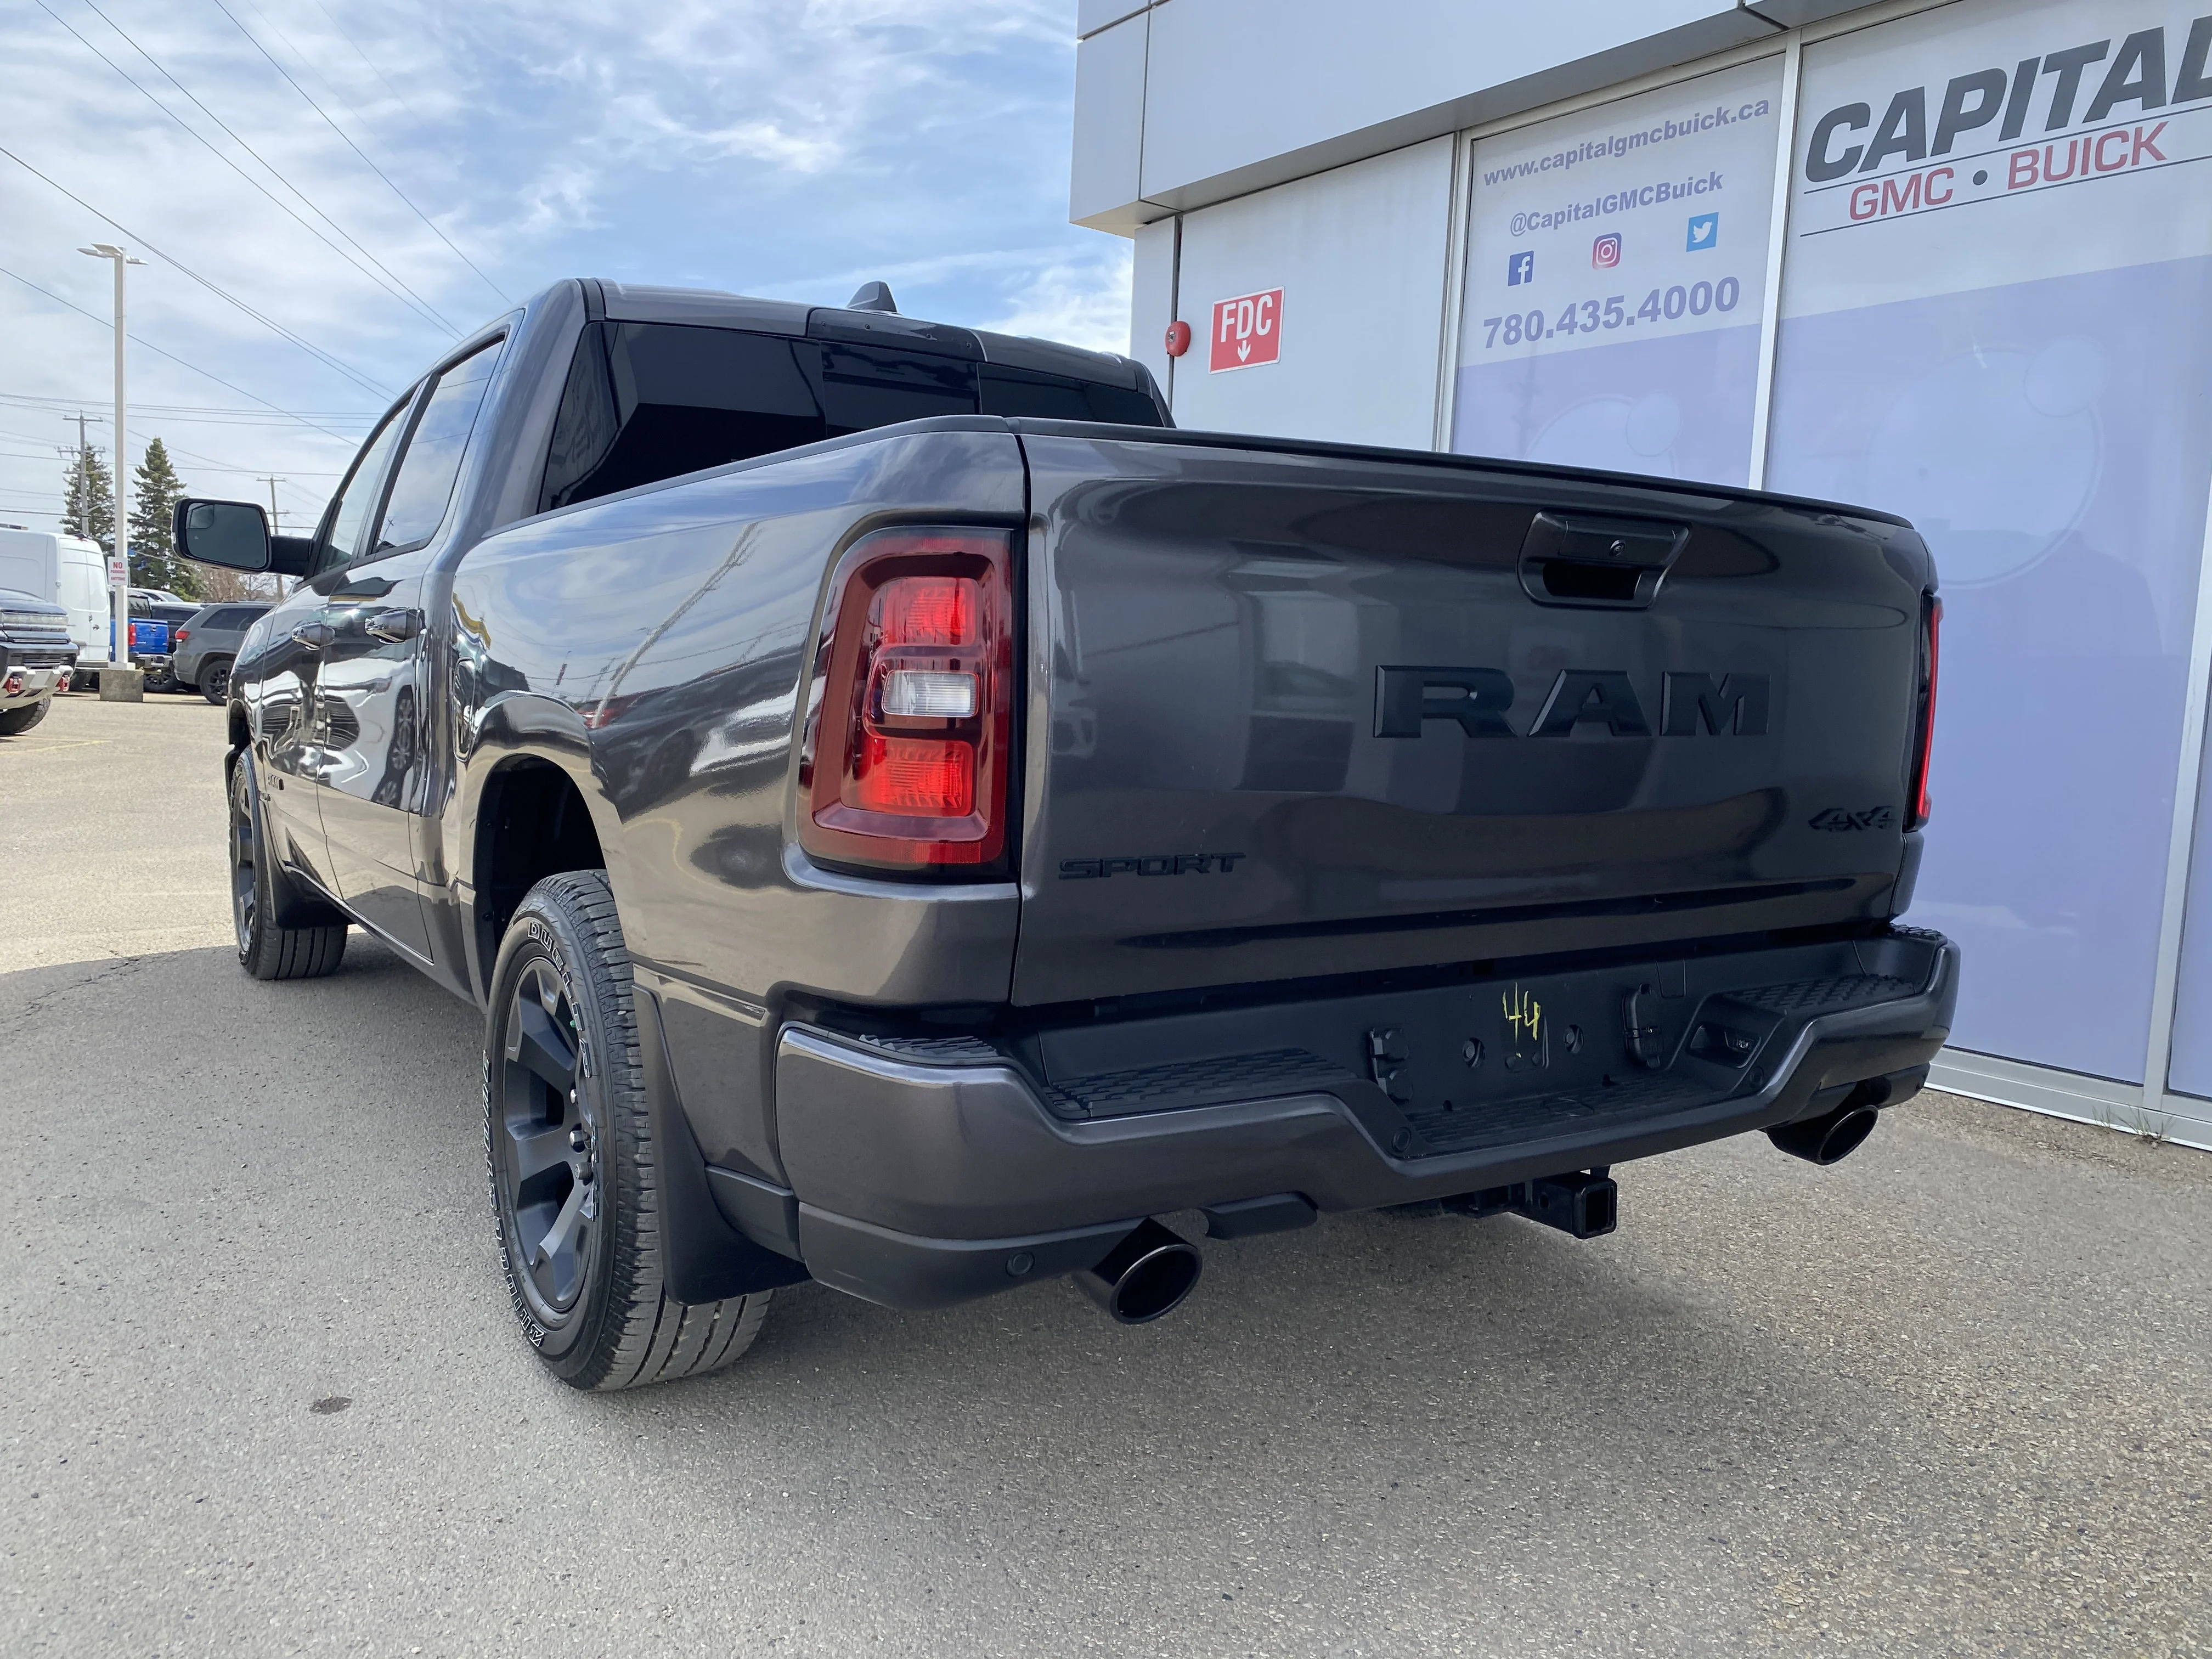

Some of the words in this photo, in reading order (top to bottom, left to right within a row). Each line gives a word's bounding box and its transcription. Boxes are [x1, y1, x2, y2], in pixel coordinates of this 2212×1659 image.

[1805, 15, 2212, 182] CAPITAL
[1483, 100, 1769, 185] www.capitalgmcbuick.ca
[1849, 167, 1954, 221] GMC
[2008, 121, 2169, 189] BUICK
[1510, 171, 1723, 236] @CapitalGMCBuick
[1221, 295, 1273, 342] FDC
[1483, 276, 1739, 348] 780.435.4000
[1373, 665, 1771, 738] RAM
[1059, 852, 1246, 880] SPORT
[1502, 982, 1541, 1043] 44
